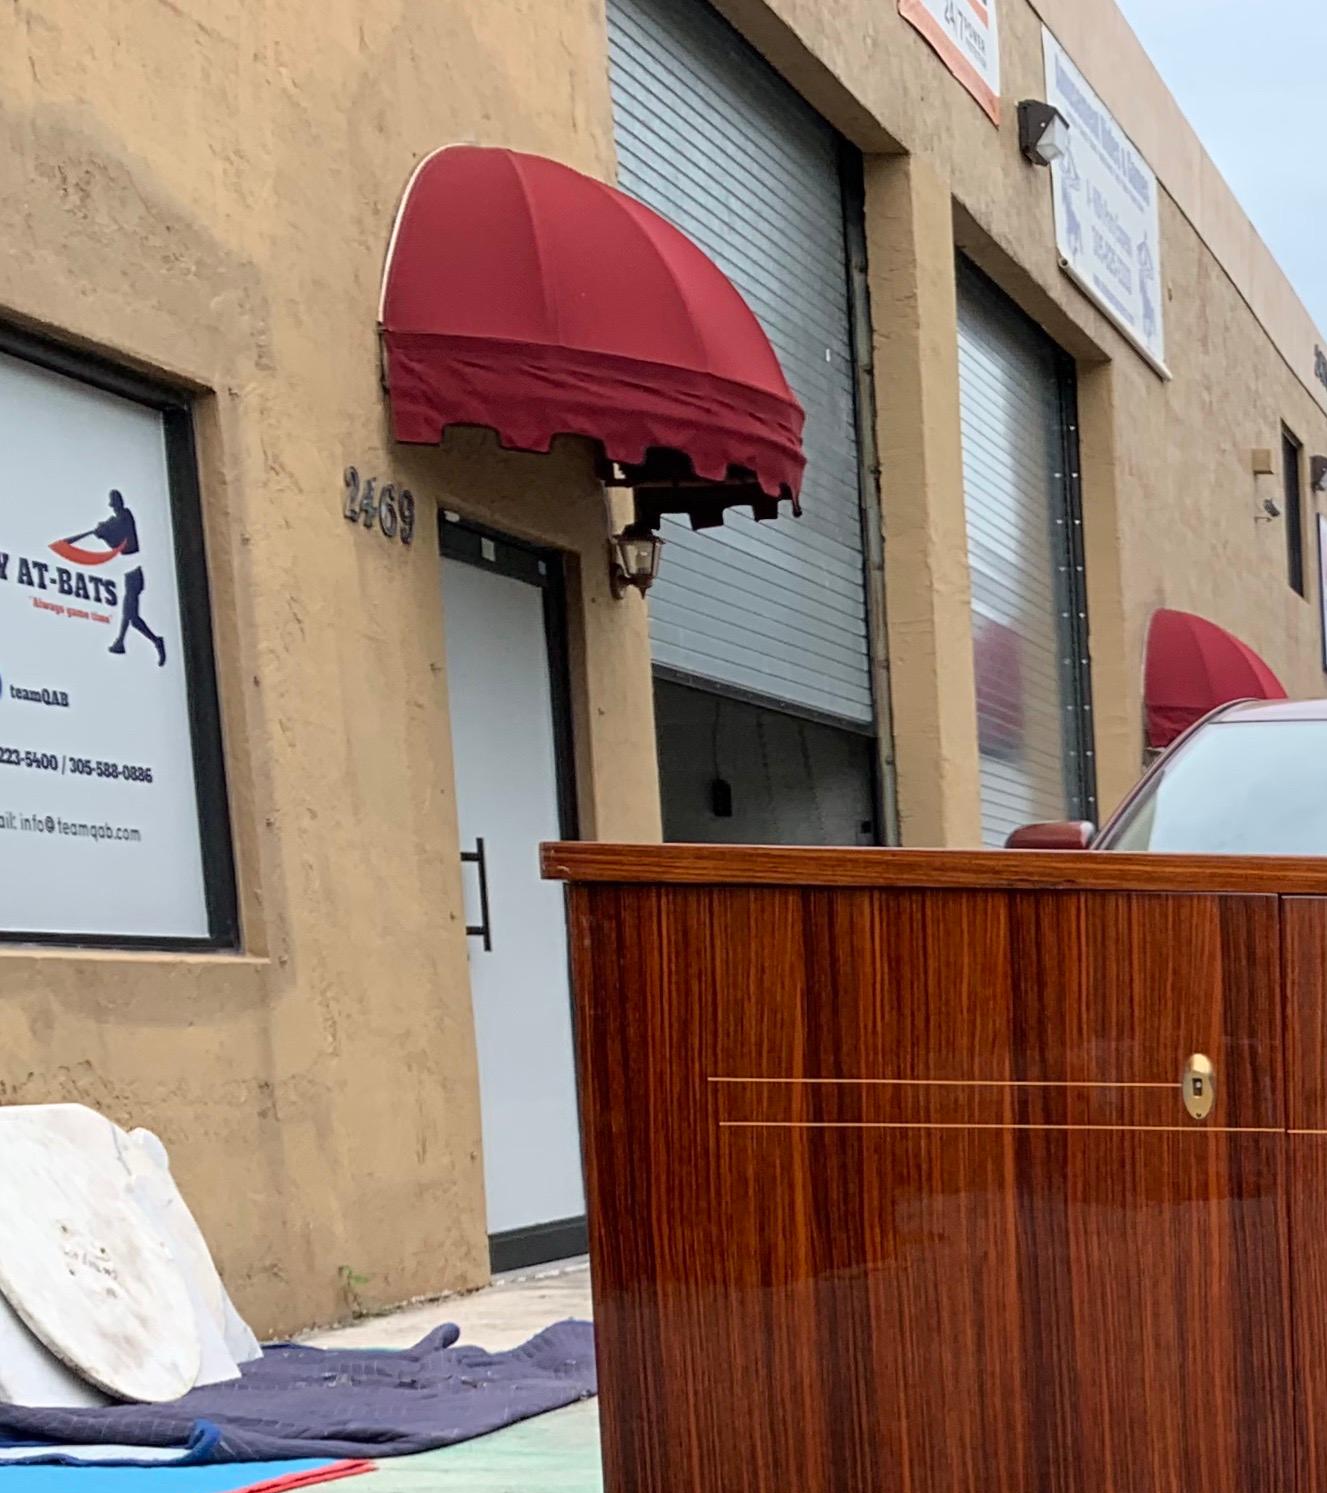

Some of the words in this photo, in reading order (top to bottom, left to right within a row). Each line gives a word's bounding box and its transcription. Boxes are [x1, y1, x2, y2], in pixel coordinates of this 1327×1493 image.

[344, 465, 415, 545] 2469
[17, 557, 118, 606] AT-BATS
[10, 684, 70, 707] teamQAB
